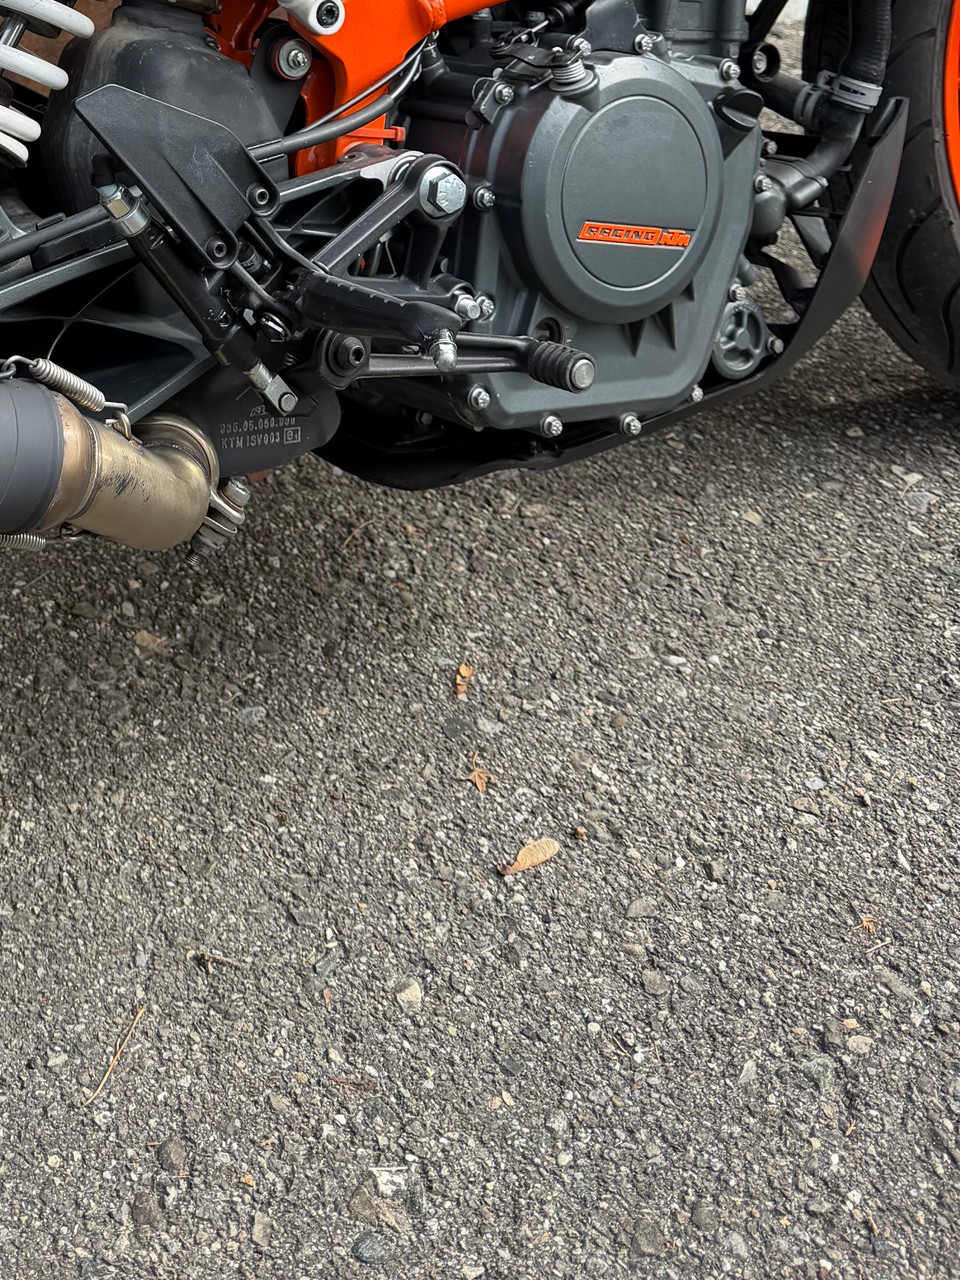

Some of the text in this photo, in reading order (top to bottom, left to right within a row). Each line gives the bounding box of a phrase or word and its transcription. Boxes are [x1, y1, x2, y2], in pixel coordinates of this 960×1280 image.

[585, 226, 691, 247] RACING KTM
[221, 435, 243, 450] KTM
